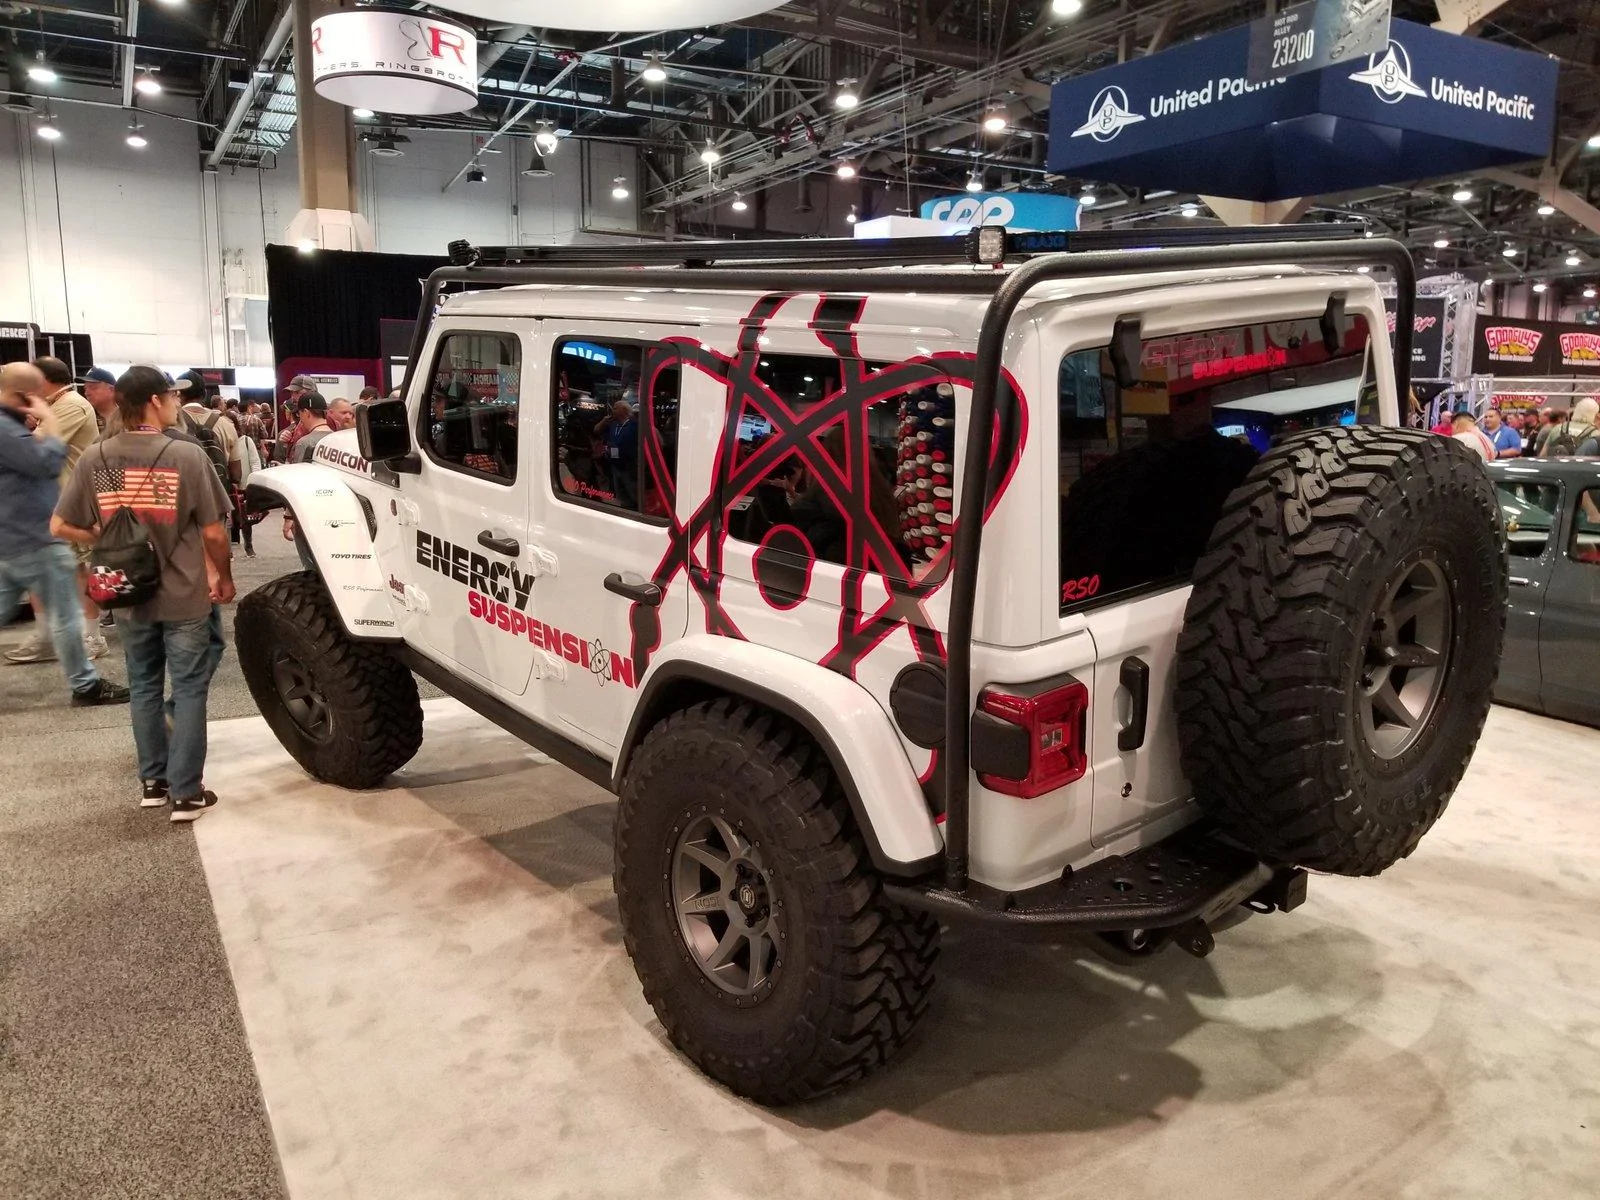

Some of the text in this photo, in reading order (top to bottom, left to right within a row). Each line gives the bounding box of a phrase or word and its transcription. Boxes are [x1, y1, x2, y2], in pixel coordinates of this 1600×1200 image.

[1273, 25, 1291, 37] ALLEY
[1272, 29, 1315, 69] 23200
[1150, 80, 1212, 118] United
[1431, 77, 1535, 121] United Pacific
[1485, 326, 1543, 354] GOODGUYS
[316, 444, 369, 473] RUBICON
[416, 529, 536, 612] ENERGY
[1062, 574, 1100, 603] RSO
[354, 618, 395, 627] SUPERWINCH
